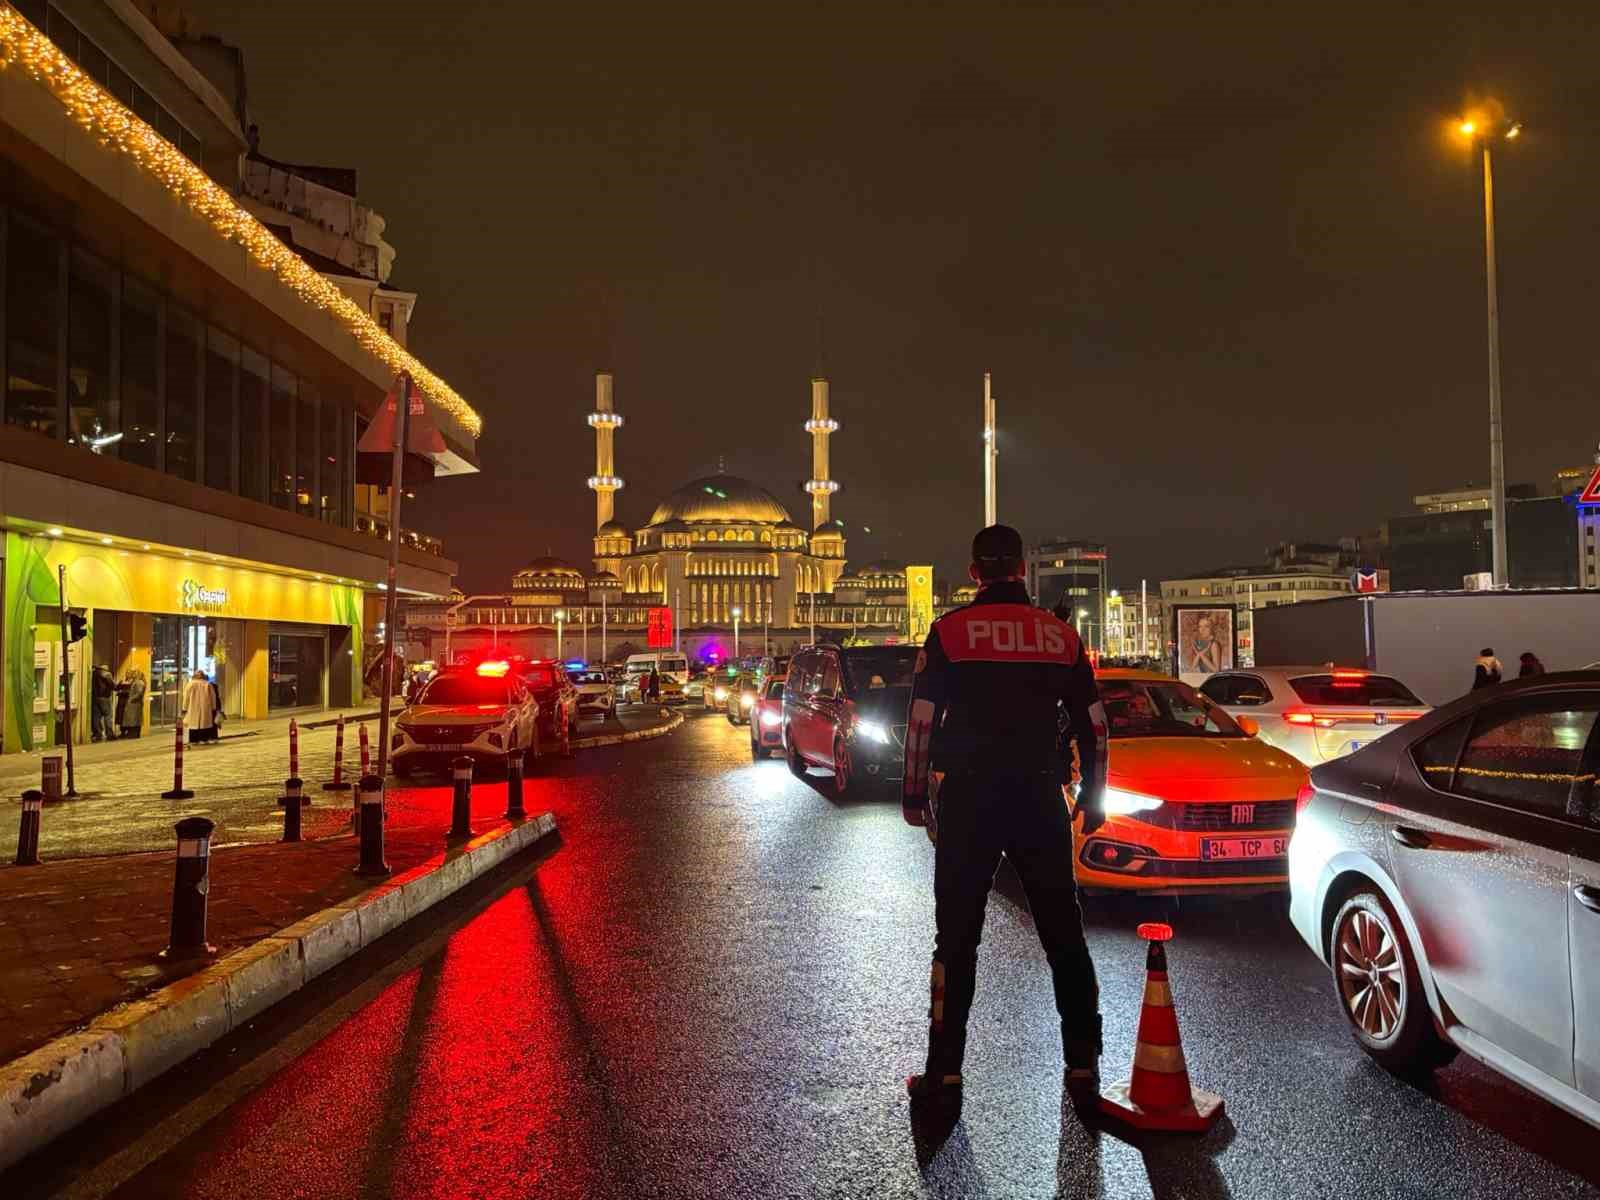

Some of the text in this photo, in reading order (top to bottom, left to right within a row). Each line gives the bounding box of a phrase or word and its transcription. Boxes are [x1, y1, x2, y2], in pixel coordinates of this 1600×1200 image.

[966, 618, 1065, 653] POLİS
[1231, 804, 1256, 824] FIAT
[1211, 842, 1227, 857] 34
[1240, 841, 1262, 856] TCP
